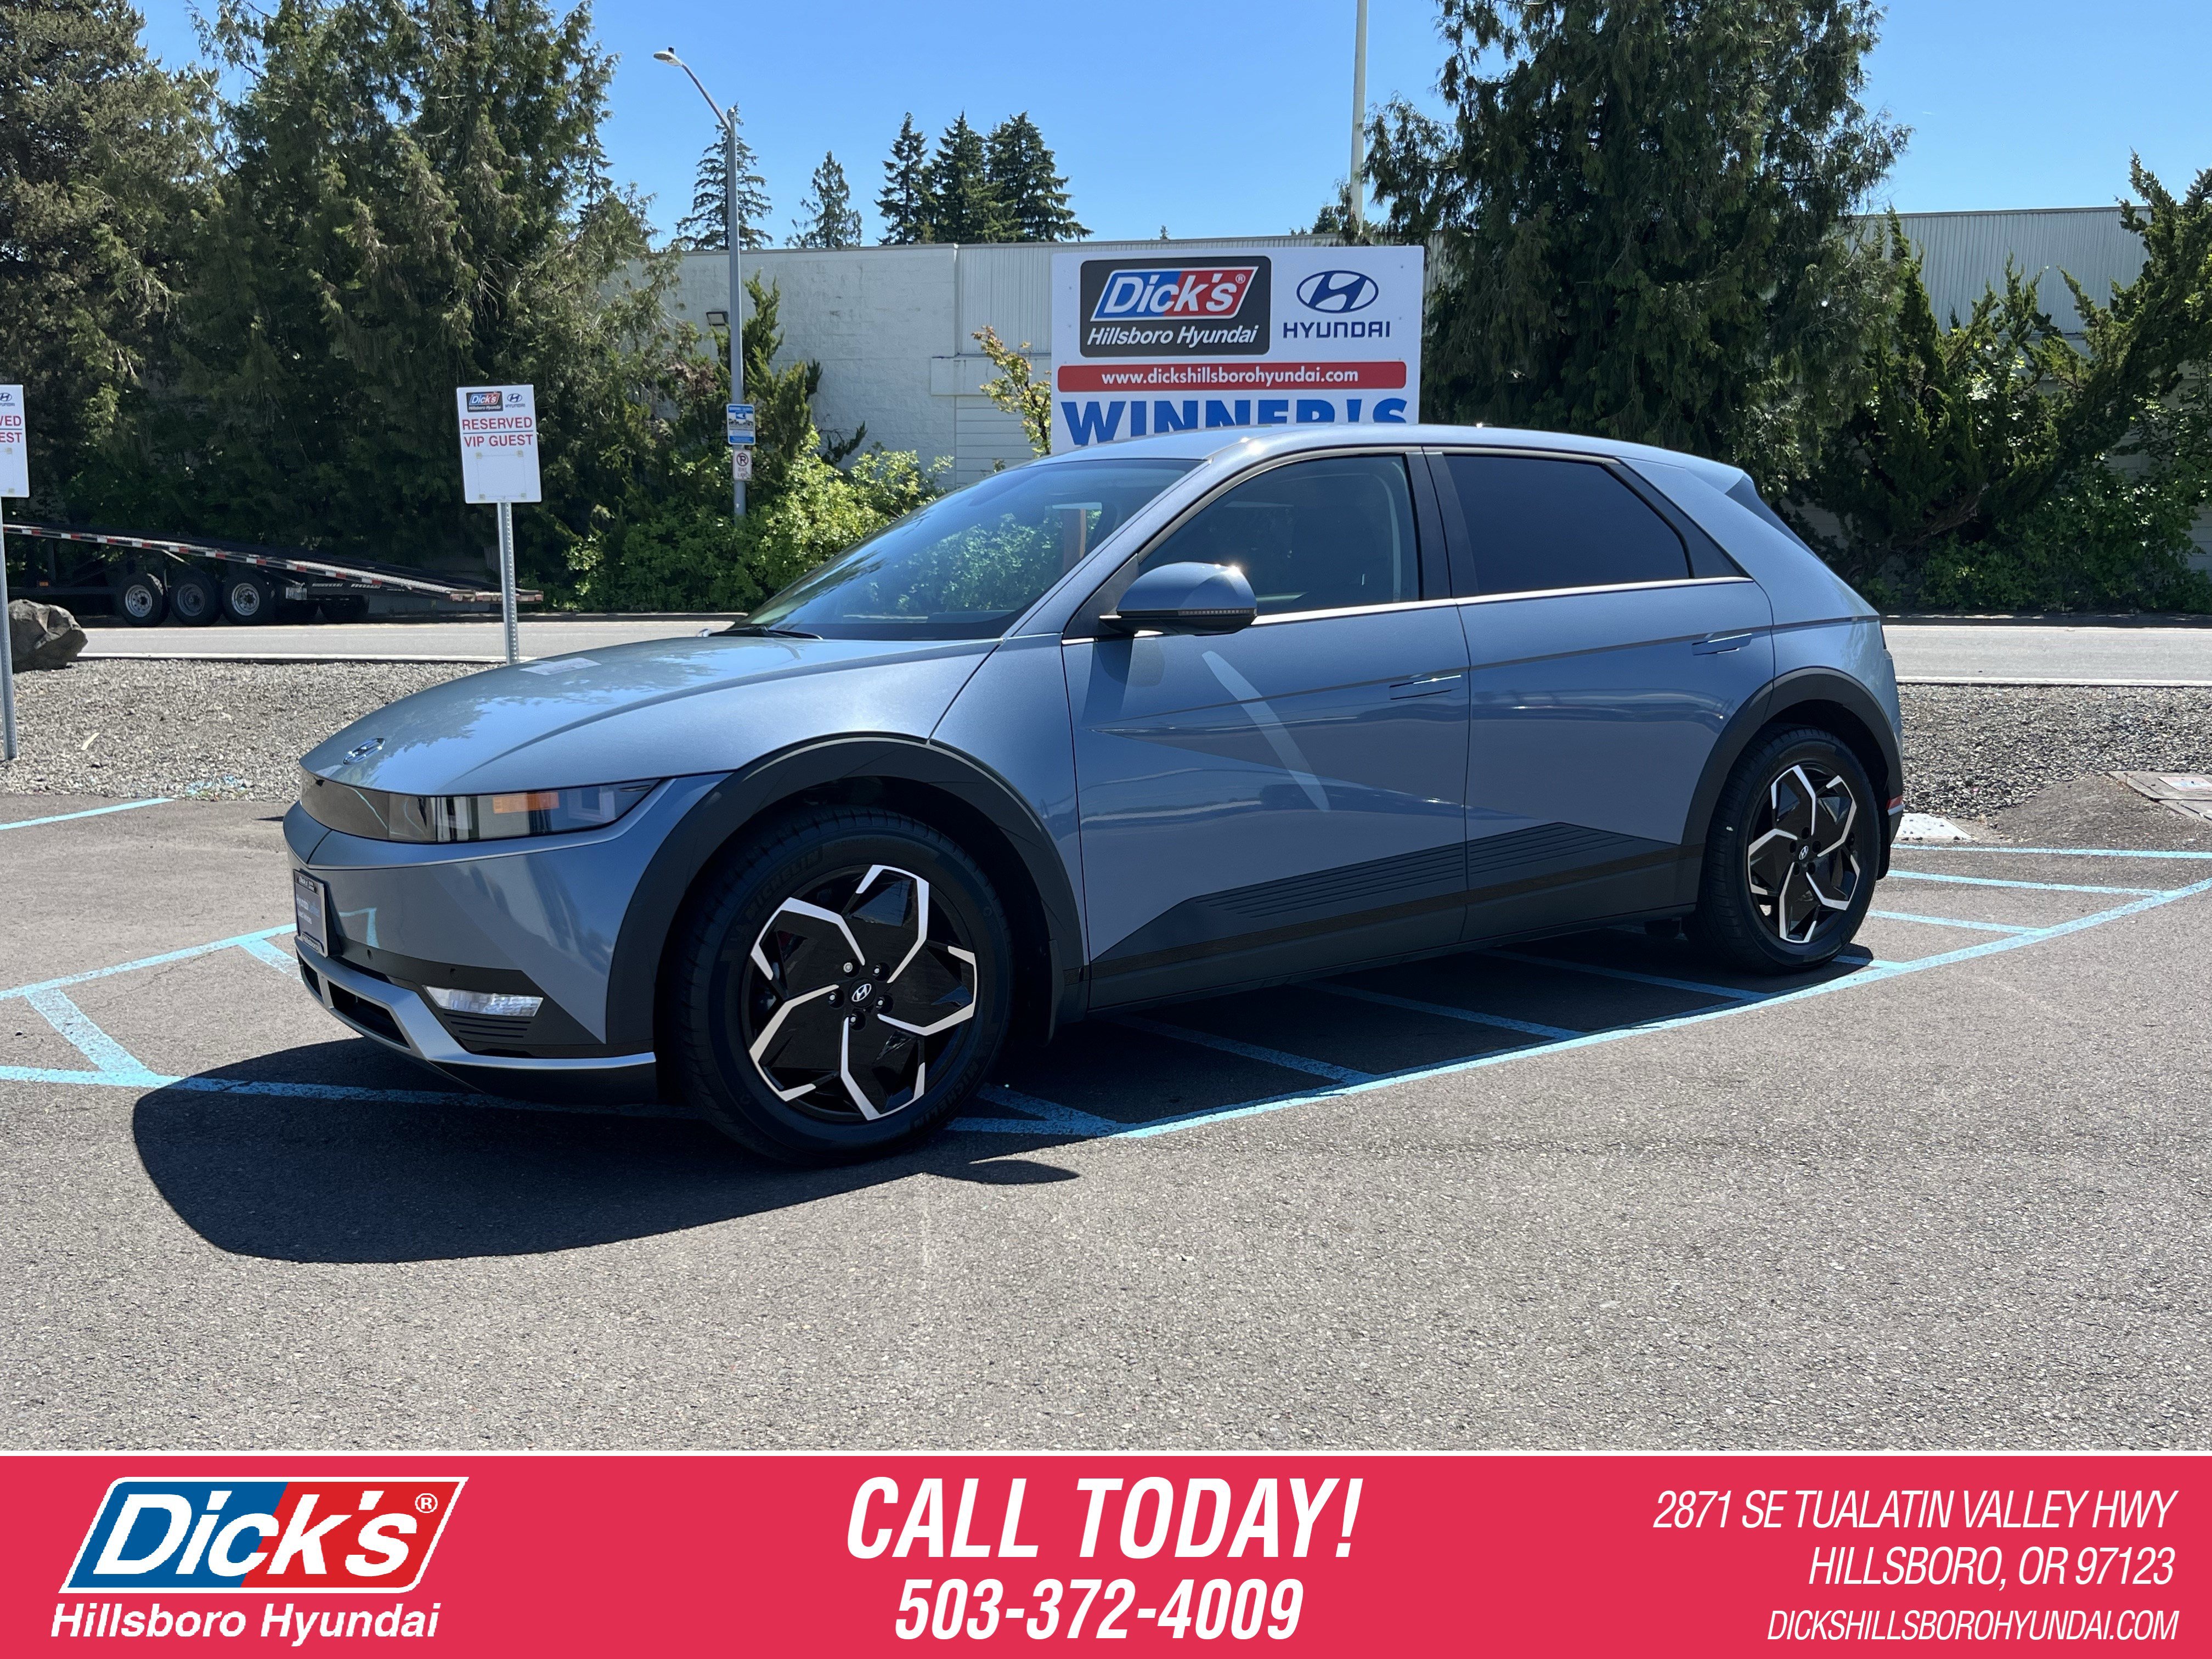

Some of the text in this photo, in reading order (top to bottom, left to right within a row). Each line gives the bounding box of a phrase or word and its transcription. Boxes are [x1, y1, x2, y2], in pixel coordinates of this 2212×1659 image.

[1087, 325, 1260, 348] Hillsboro Hyundai
[1283, 321, 1391, 338] HYUNDAI
[1102, 366, 1358, 387] www.dickshillsborohyundai.com
[462, 417, 533, 430] RESERVED
[464, 434, 533, 447] VIP GUEST
